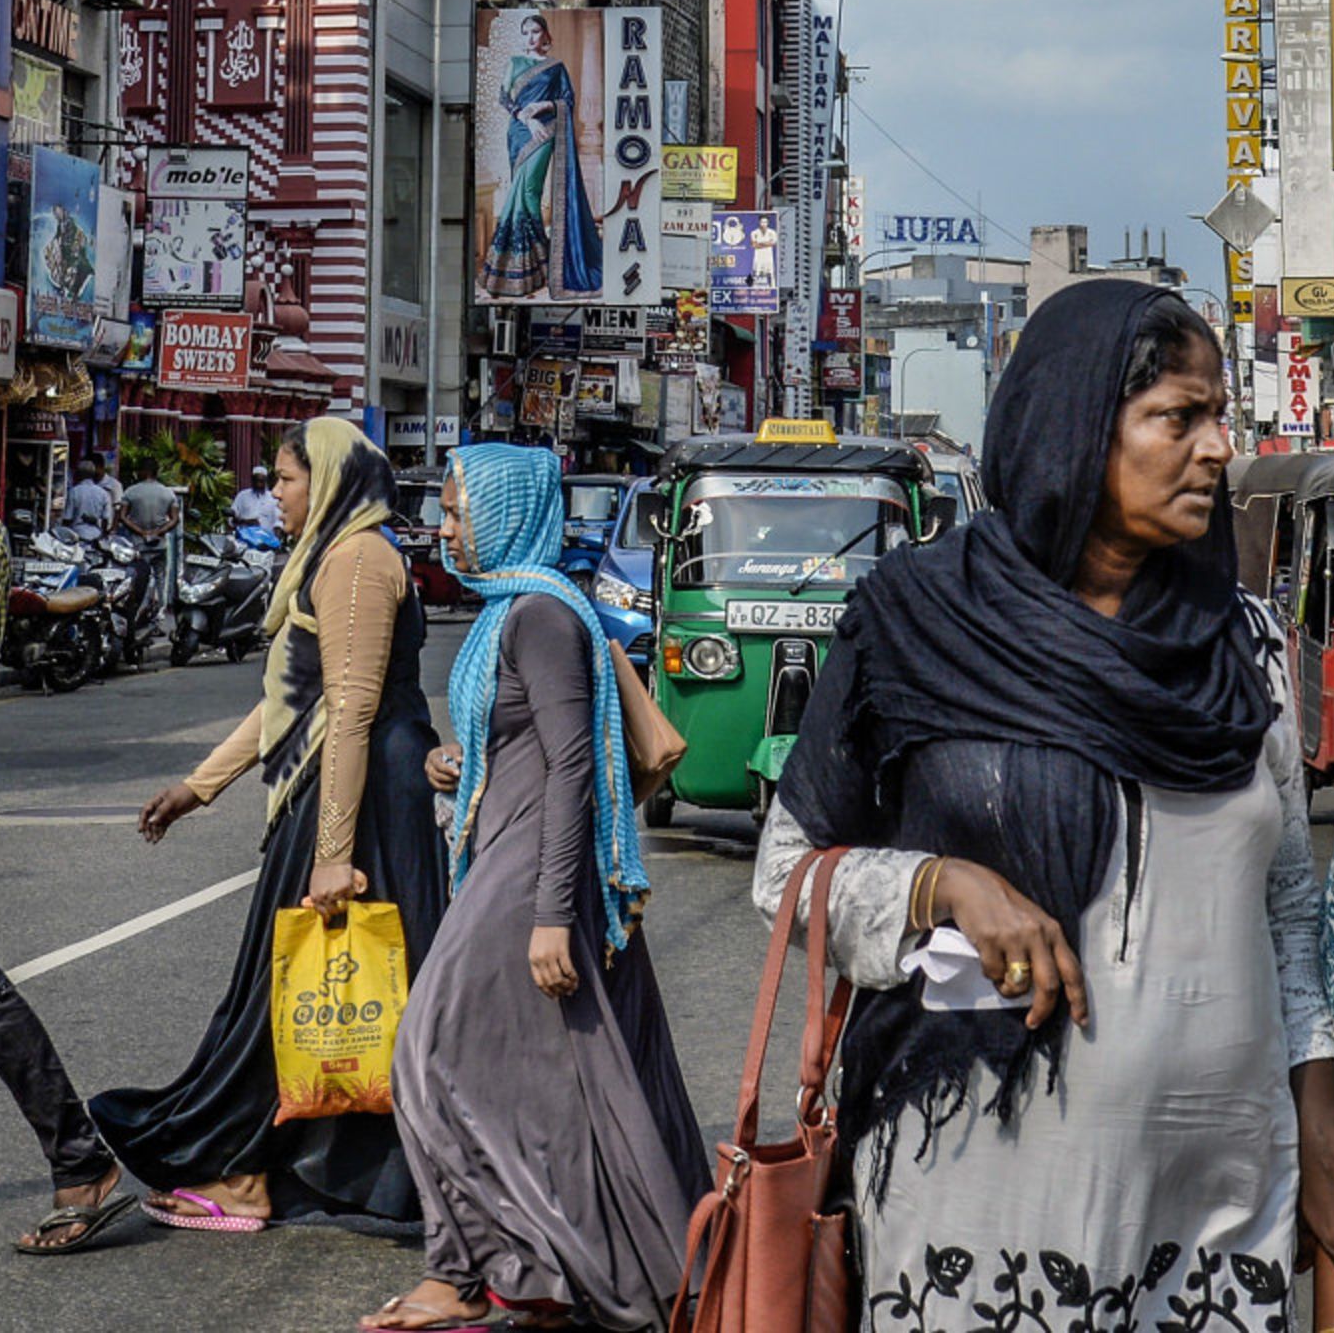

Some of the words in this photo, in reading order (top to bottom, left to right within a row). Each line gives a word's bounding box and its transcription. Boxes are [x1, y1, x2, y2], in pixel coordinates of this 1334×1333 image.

[813, 16, 833, 109] MALIBAN
[605, 15, 658, 296] RAMONAS
[662, 152, 734, 171] GANIC
[662, 221, 685, 232] ZAM
[686, 221, 709, 232] ZAM
[165, 323, 248, 350] BOMBAY
[173, 351, 236, 373] SWEETS
[529, 370, 556, 385] BIG
[738, 559, 799, 575] Suranga
[750, 605, 780, 626] QZ
